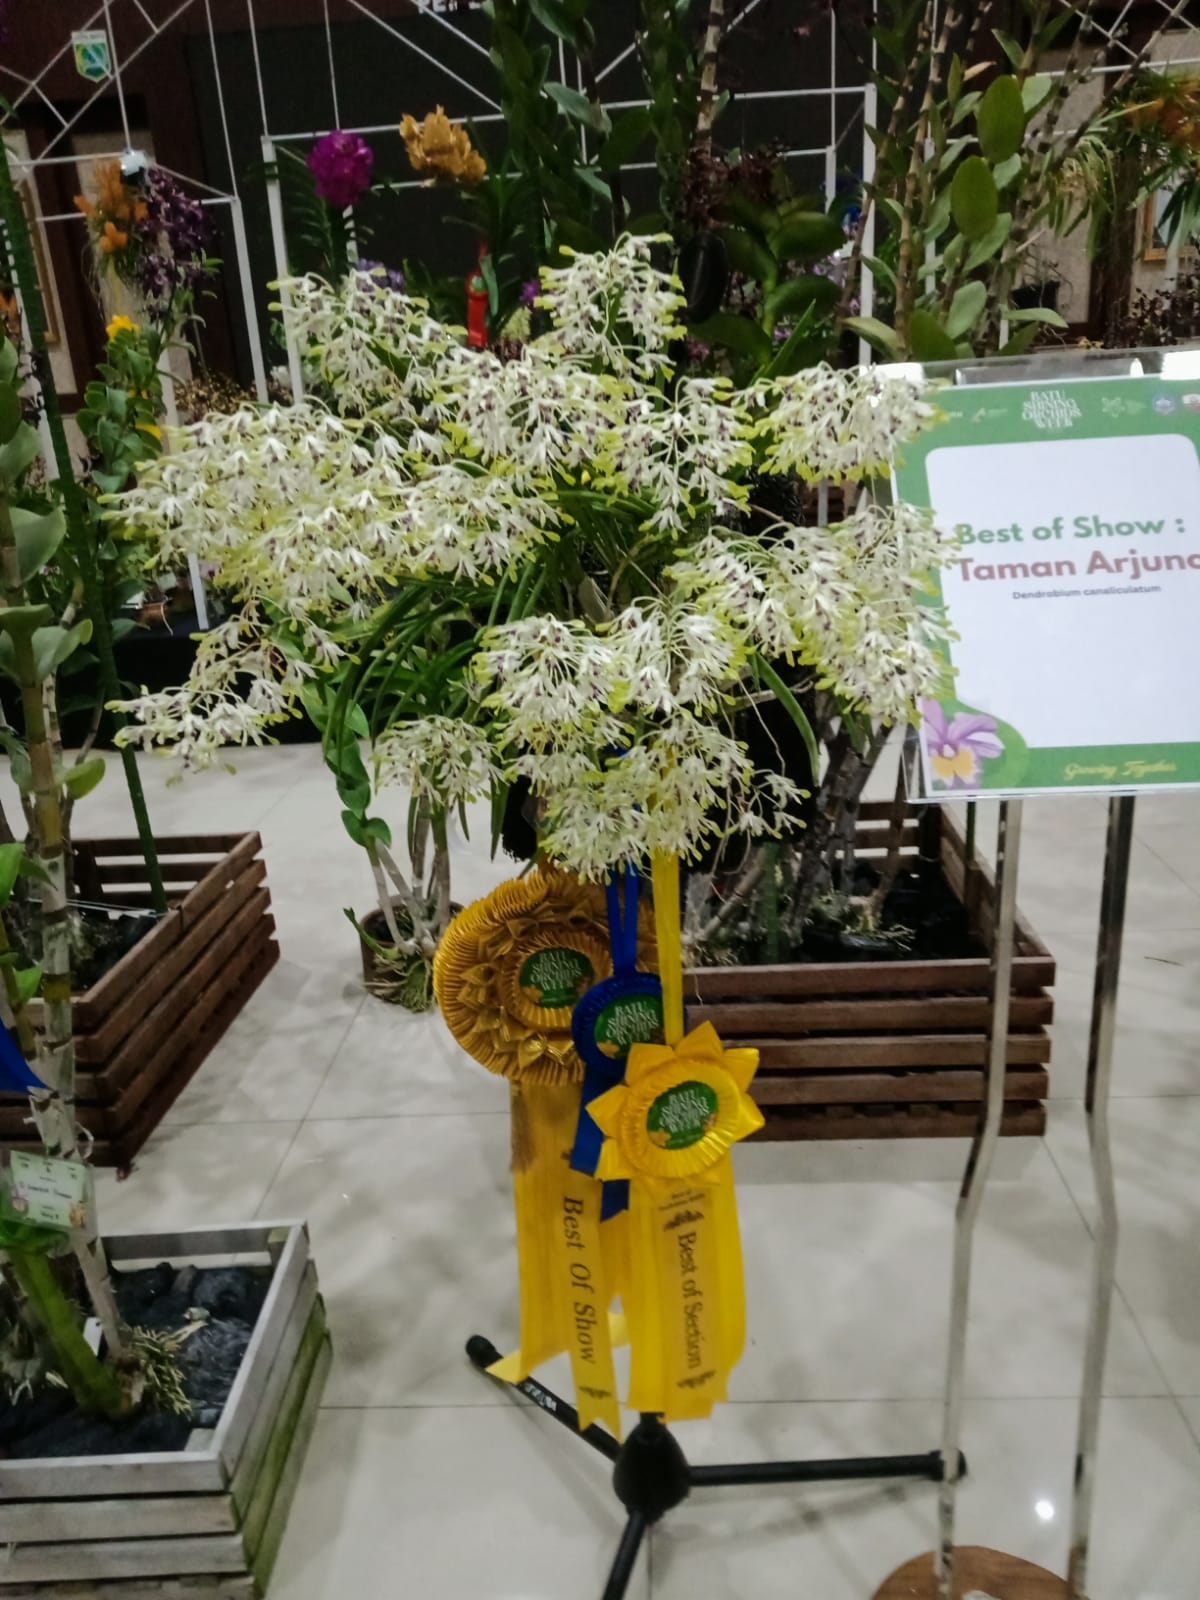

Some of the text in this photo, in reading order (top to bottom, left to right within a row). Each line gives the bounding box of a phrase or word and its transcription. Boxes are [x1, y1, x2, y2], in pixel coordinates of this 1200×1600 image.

[957, 523, 1024, 545] Best
[1032, 516, 1064, 541] of
[1073, 515, 1165, 539] Show
[958, 557, 1076, 582] Taman
[1012, 584, 1161, 600] Dendrobium canaliculatum
[563, 1195, 597, 1364] Best Of Show
[678, 1232, 706, 1369] Best of Section
